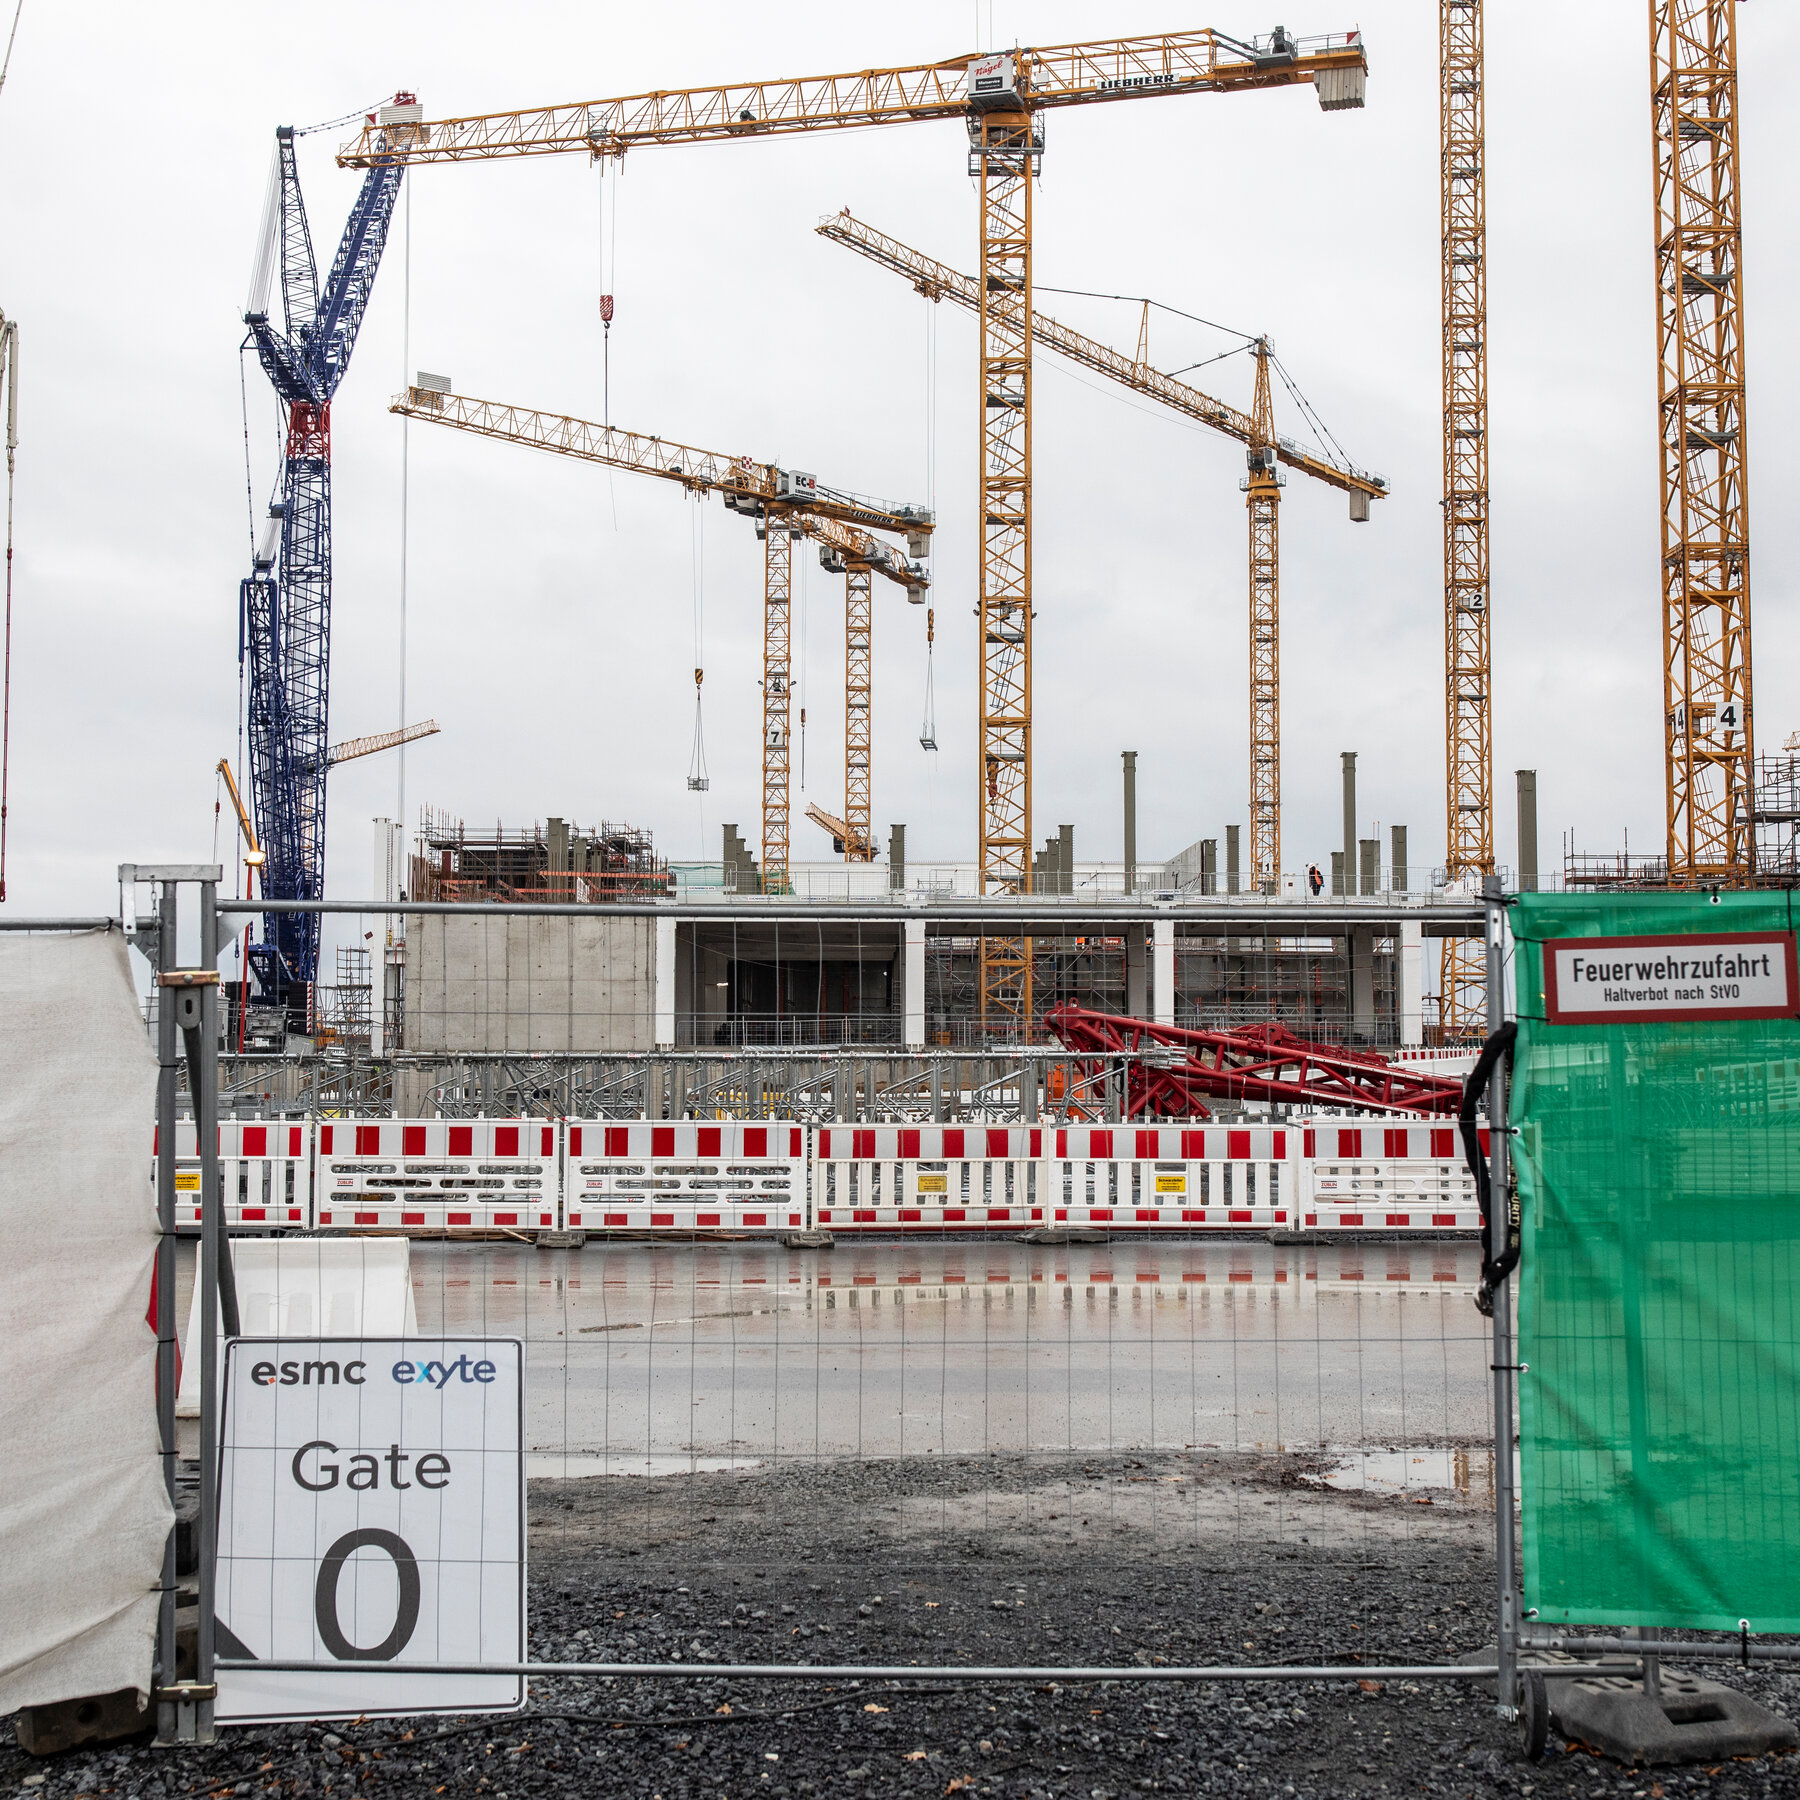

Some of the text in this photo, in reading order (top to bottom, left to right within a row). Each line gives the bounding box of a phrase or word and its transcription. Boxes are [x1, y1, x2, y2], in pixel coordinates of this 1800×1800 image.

[1101, 74, 1174, 89] LIEBHERR
[795, 475, 815, 489] EC-B
[855, 511, 893, 523] LIEBHERR
[1473, 594, 1482, 606] 2
[1677, 708, 1684, 729] 4
[1720, 706, 1736, 727] 4
[771, 731, 779, 743] 7
[1573, 953, 1770, 982] Feuerwehrzufahrt
[1604, 984, 1740, 1002] Haltverbot nach StVO
[251, 1354, 497, 1389] esmc exyte
[292, 1440, 451, 1492] Gate
[315, 1528, 421, 1662] 0
